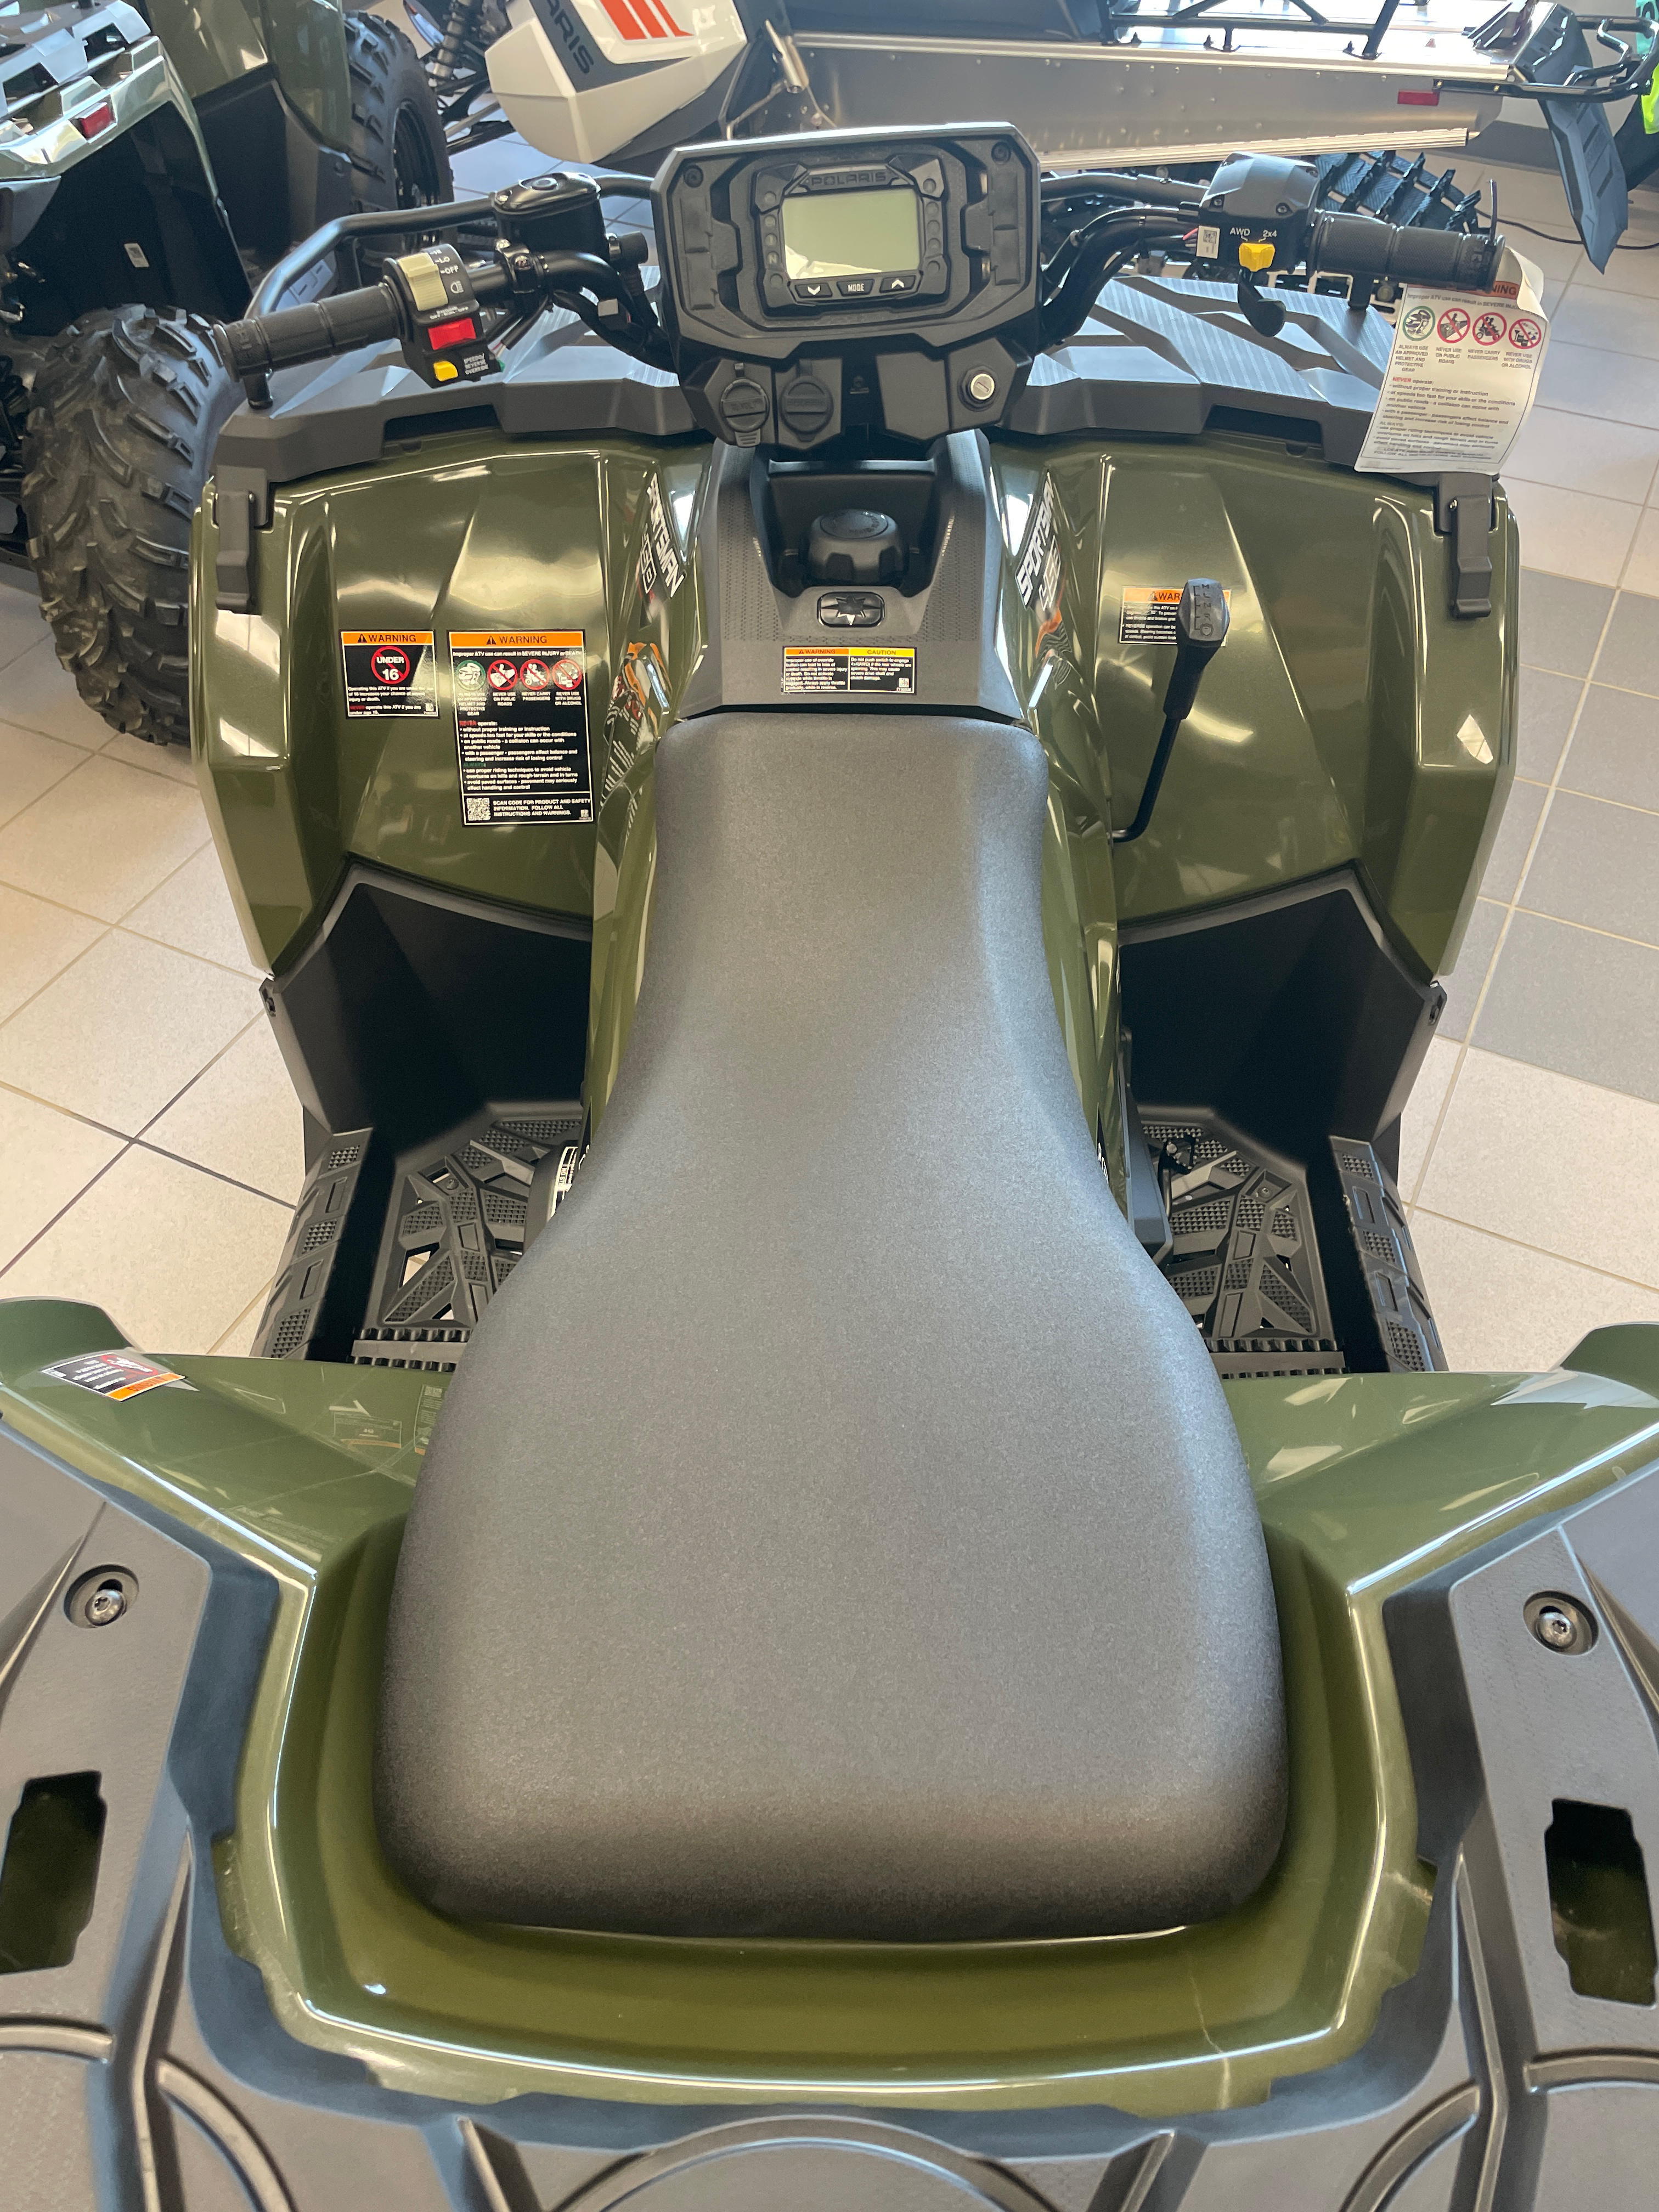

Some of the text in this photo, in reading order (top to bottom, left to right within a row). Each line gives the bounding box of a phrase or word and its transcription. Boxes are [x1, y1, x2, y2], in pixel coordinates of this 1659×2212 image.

[811, 171, 887, 186] POLARIS
[1230, 228, 1250, 236] AWD
[444, 265, 459, 274] OFF
[848, 283, 864, 292] MODE
[382, 668, 399, 681] 16
